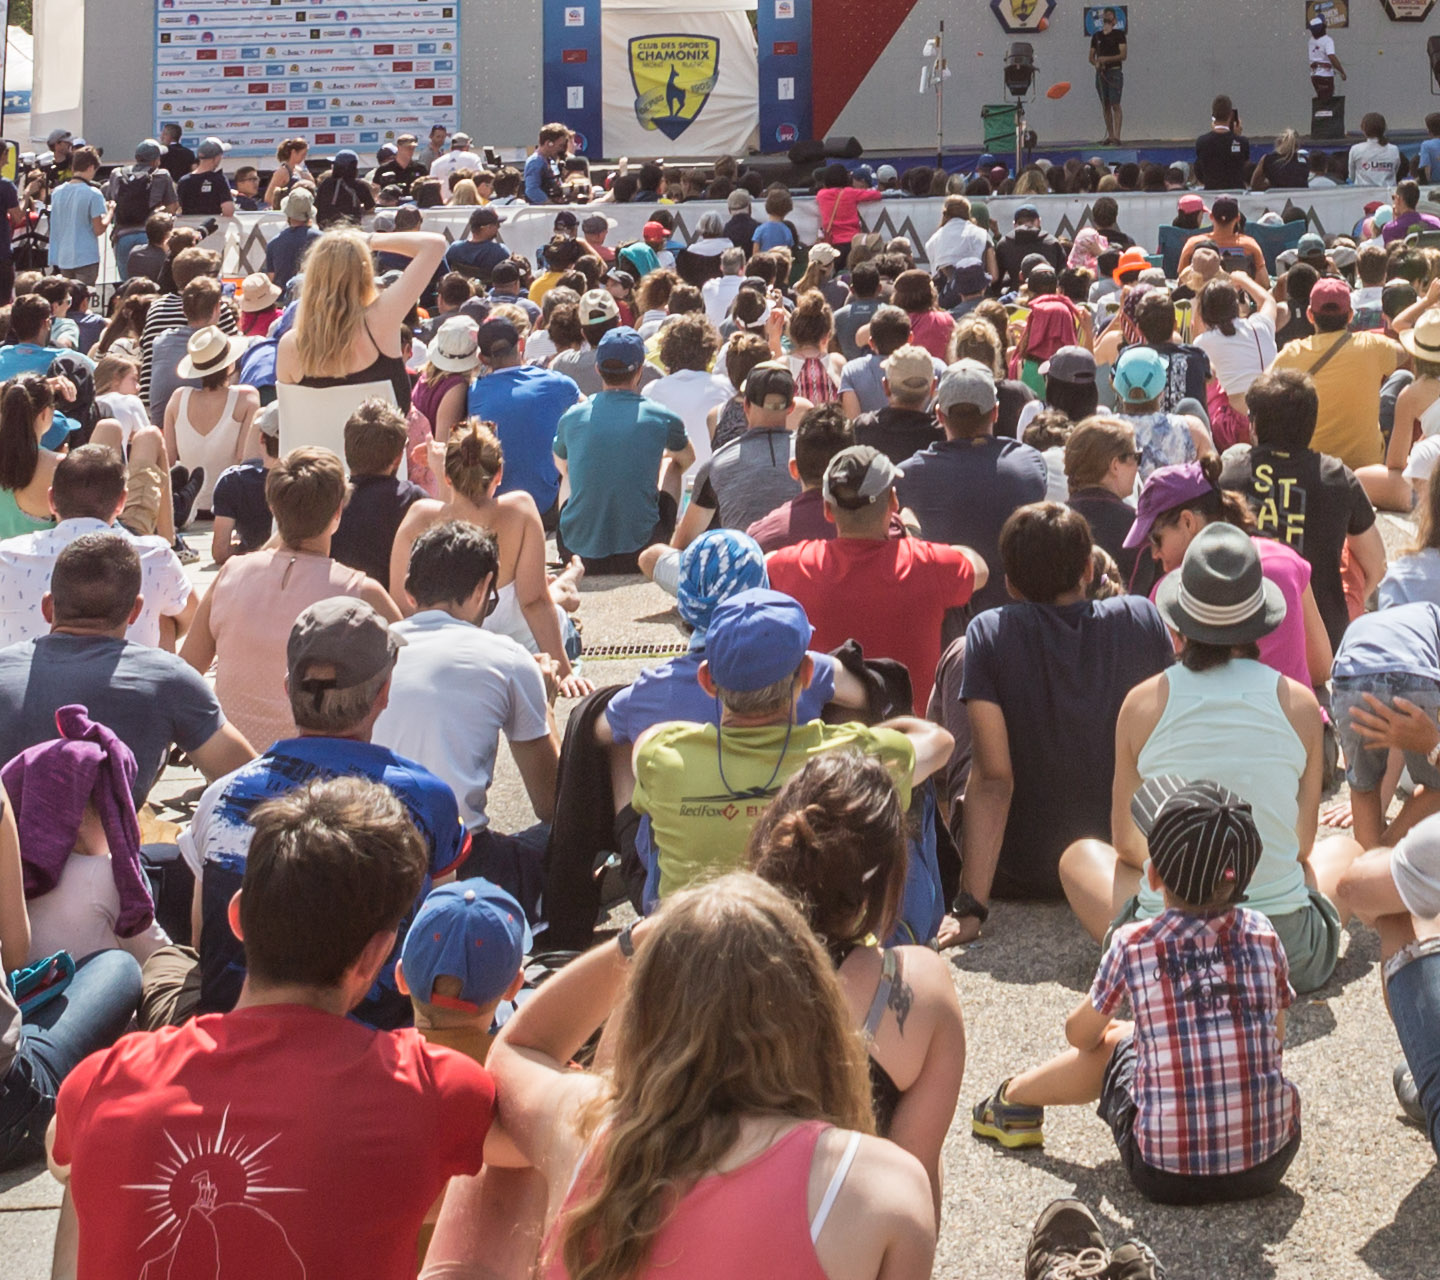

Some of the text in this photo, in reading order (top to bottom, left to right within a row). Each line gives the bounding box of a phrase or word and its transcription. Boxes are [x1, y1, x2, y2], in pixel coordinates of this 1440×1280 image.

[637, 41, 709, 50] CLUB DES SPORTS
[636, 50, 710, 61] CHAMONIX
[1371, 160, 1394, 169] USA
